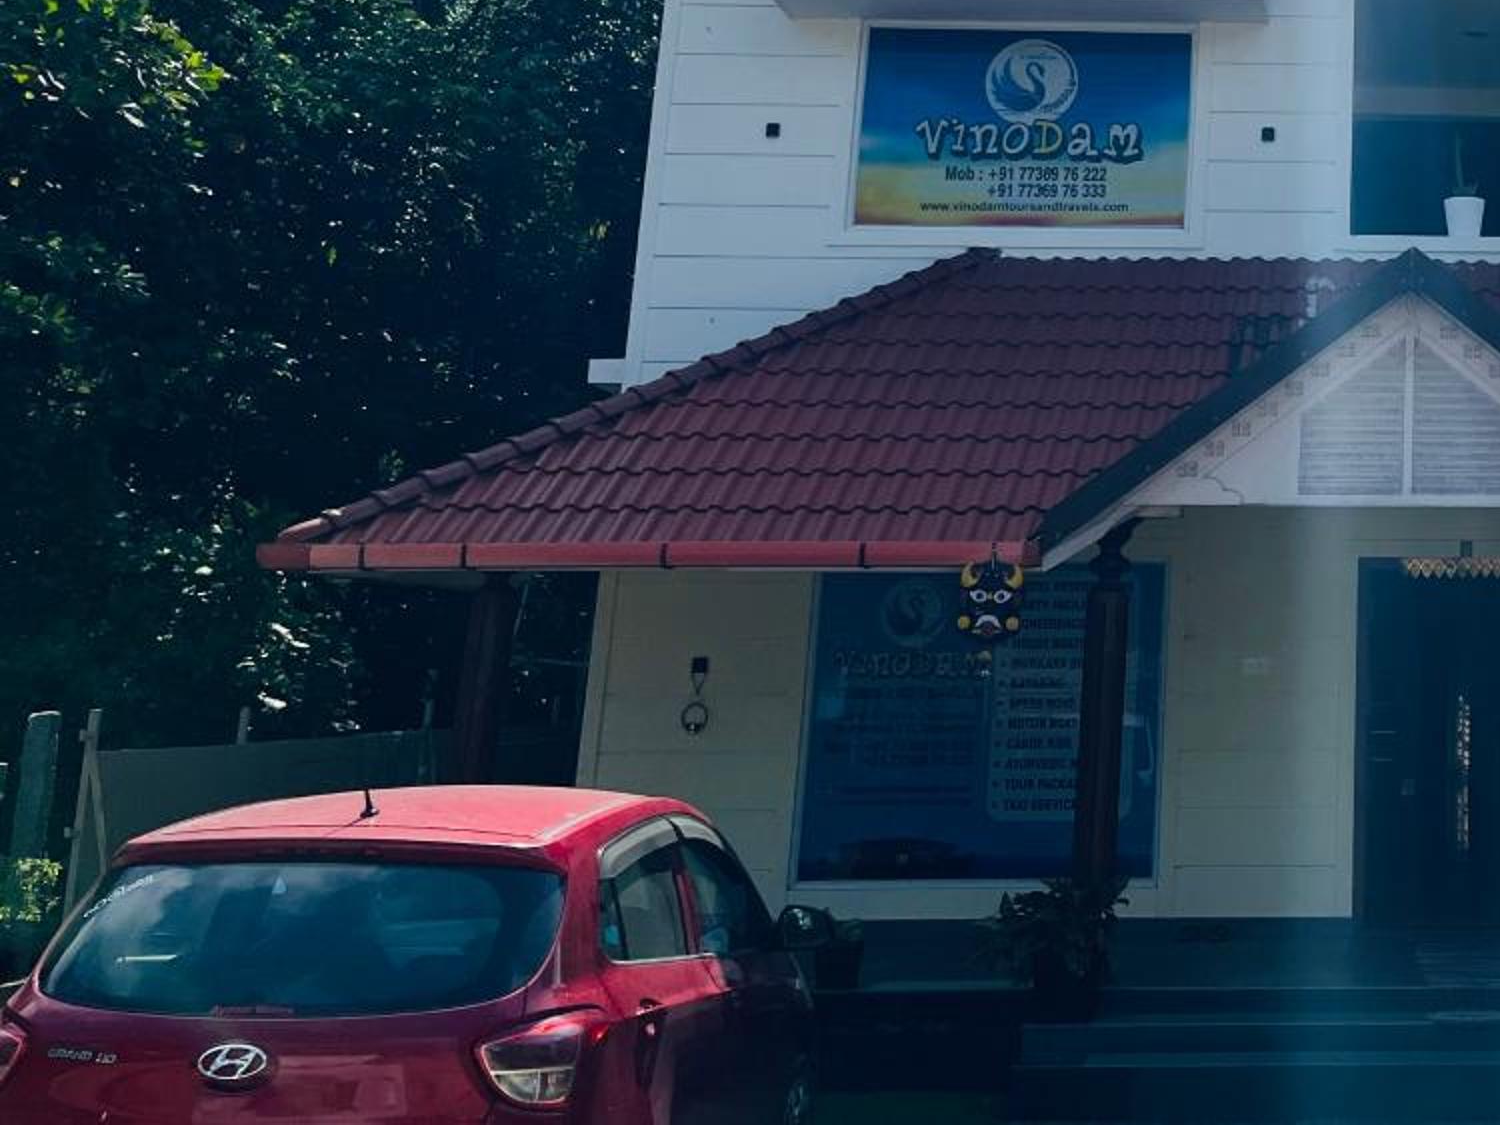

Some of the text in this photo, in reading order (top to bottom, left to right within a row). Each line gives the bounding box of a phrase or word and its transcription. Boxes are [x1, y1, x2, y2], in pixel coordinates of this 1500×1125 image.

[915, 118, 1143, 161] VinoDam
[989, 167, 1014, 181] +91
[1063, 167, 1079, 181] 76
[1082, 167, 1107, 181] 222
[988, 184, 1014, 198] +91
[1018, 184, 1058, 198] 77369
[1081, 184, 1107, 198] 333
